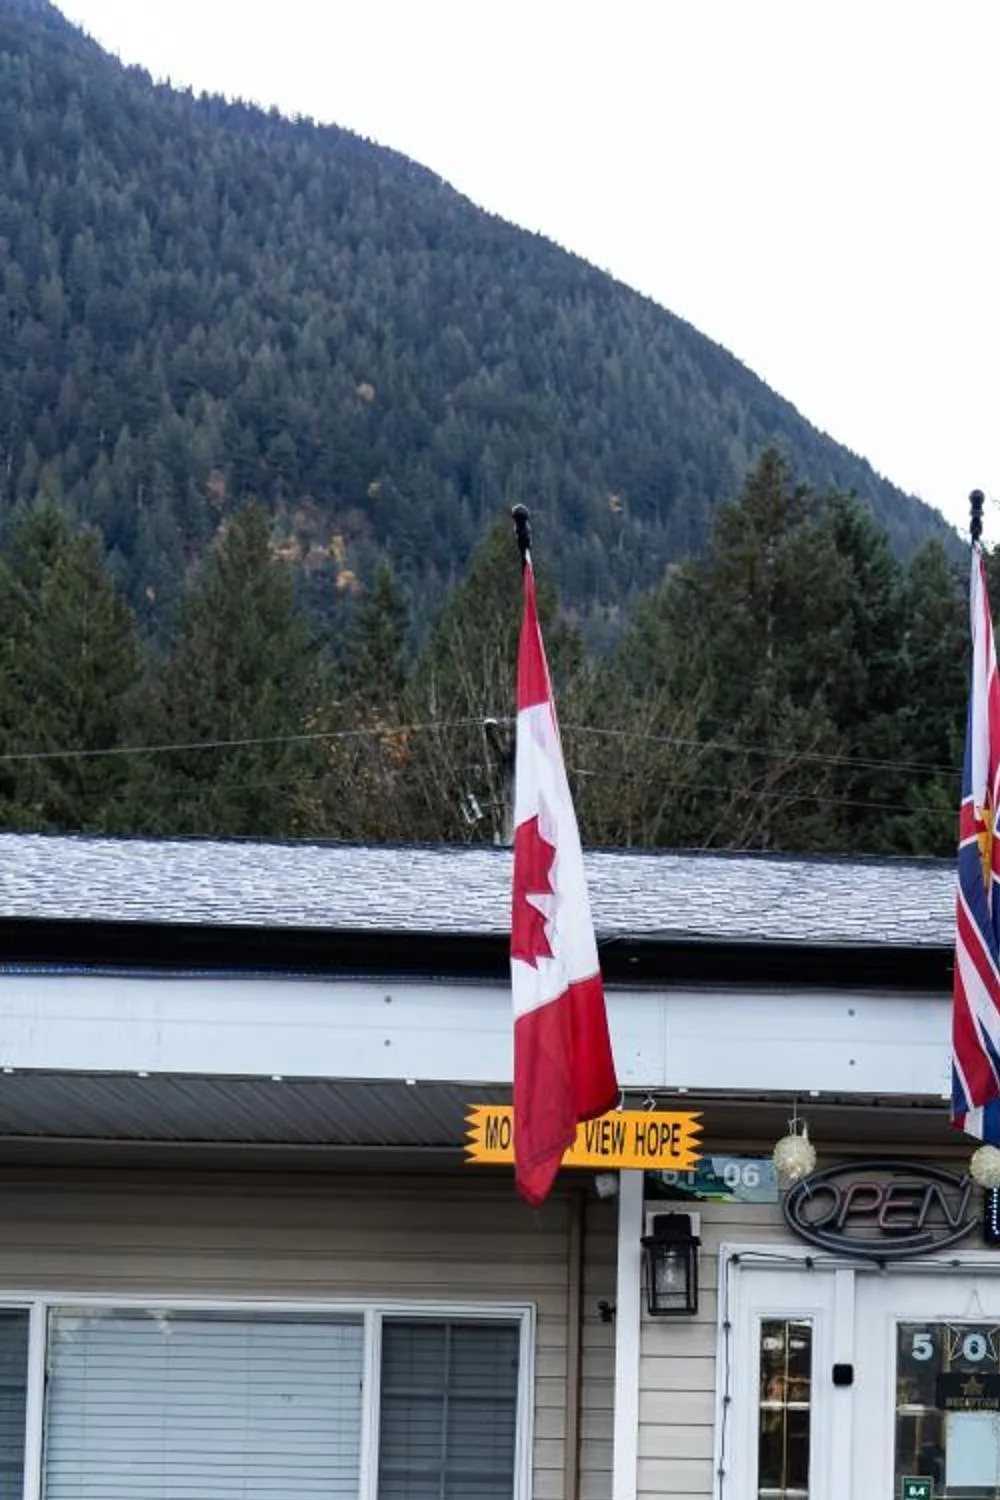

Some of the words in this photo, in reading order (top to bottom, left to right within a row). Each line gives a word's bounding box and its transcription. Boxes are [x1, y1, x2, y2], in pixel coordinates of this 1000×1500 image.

[584, 1120, 626, 1155] VIEW
[634, 1122, 681, 1157] HOPE
[723, 1162, 761, 1188] 06
[794, 1183, 972, 1228] OPEN
